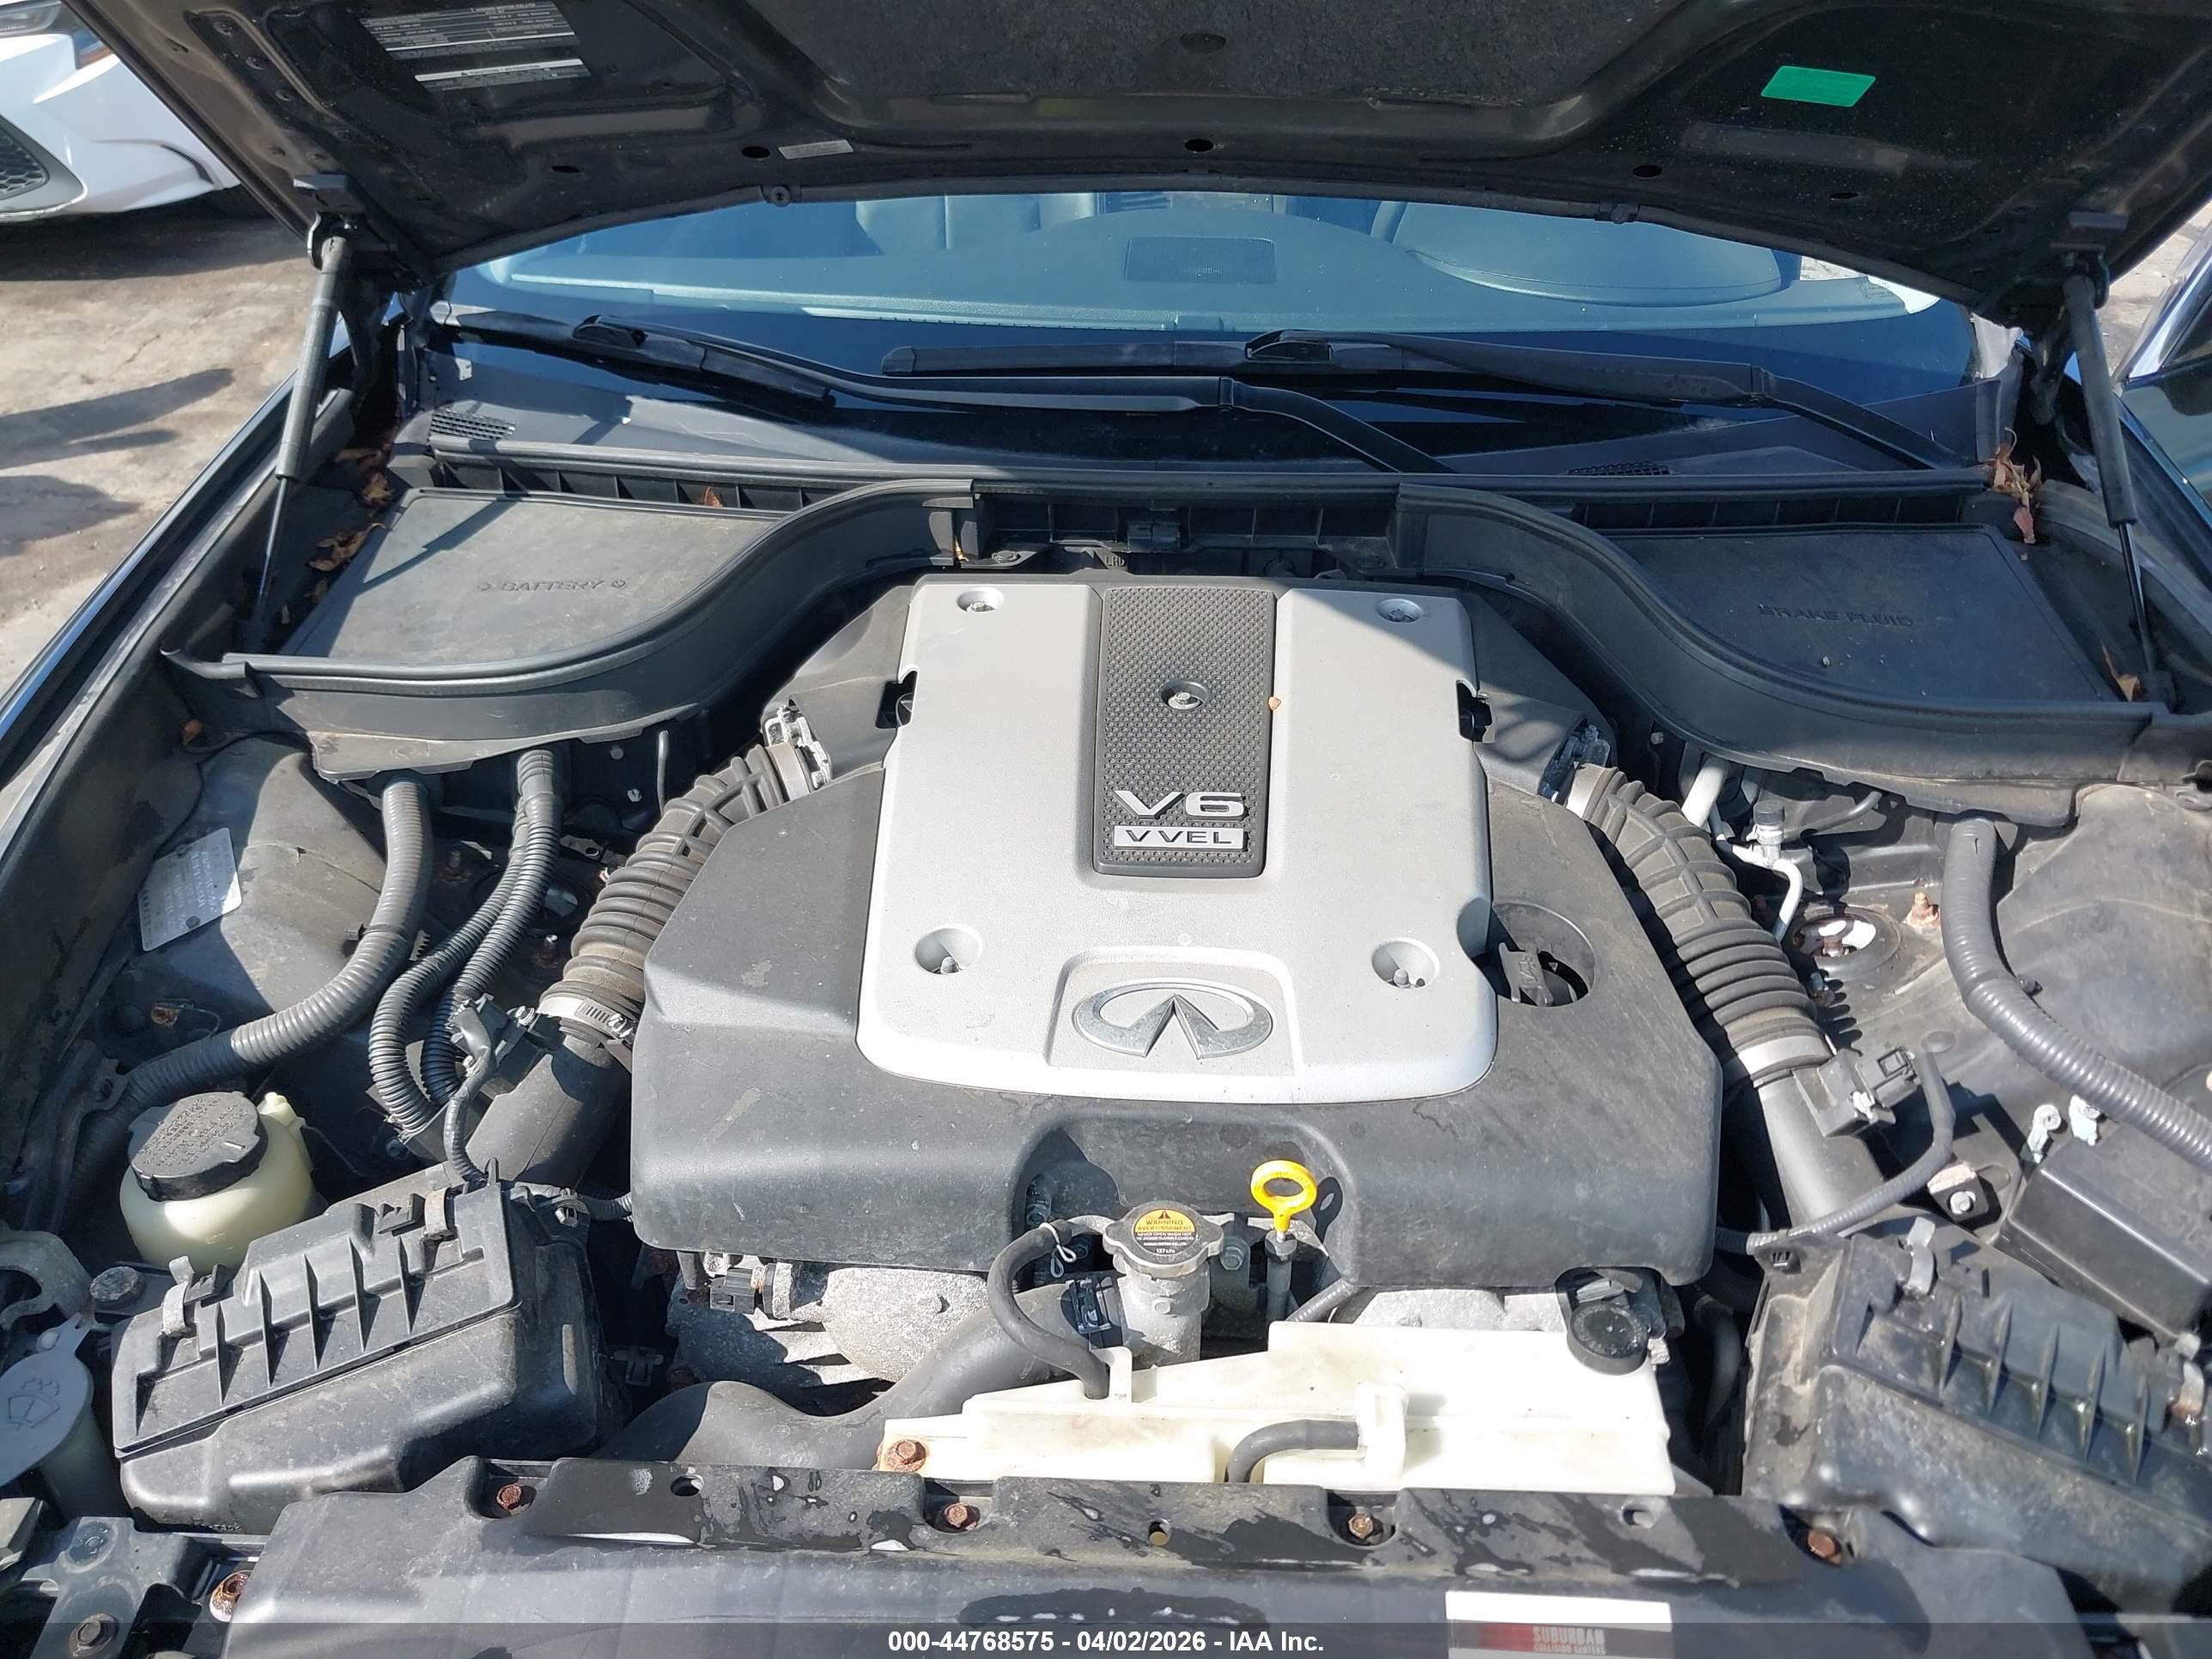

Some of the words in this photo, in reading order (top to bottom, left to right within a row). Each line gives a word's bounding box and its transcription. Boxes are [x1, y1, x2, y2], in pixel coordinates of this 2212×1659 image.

[501, 580, 605, 592] BATTERY
[1758, 605, 1839, 622] BRAKE
[1845, 611, 1914, 628] FLUID
[1114, 790, 1247, 822] V6
[1125, 830, 1232, 844] VVEL
[1533, 1626, 1605, 1644] SUBURBAN
